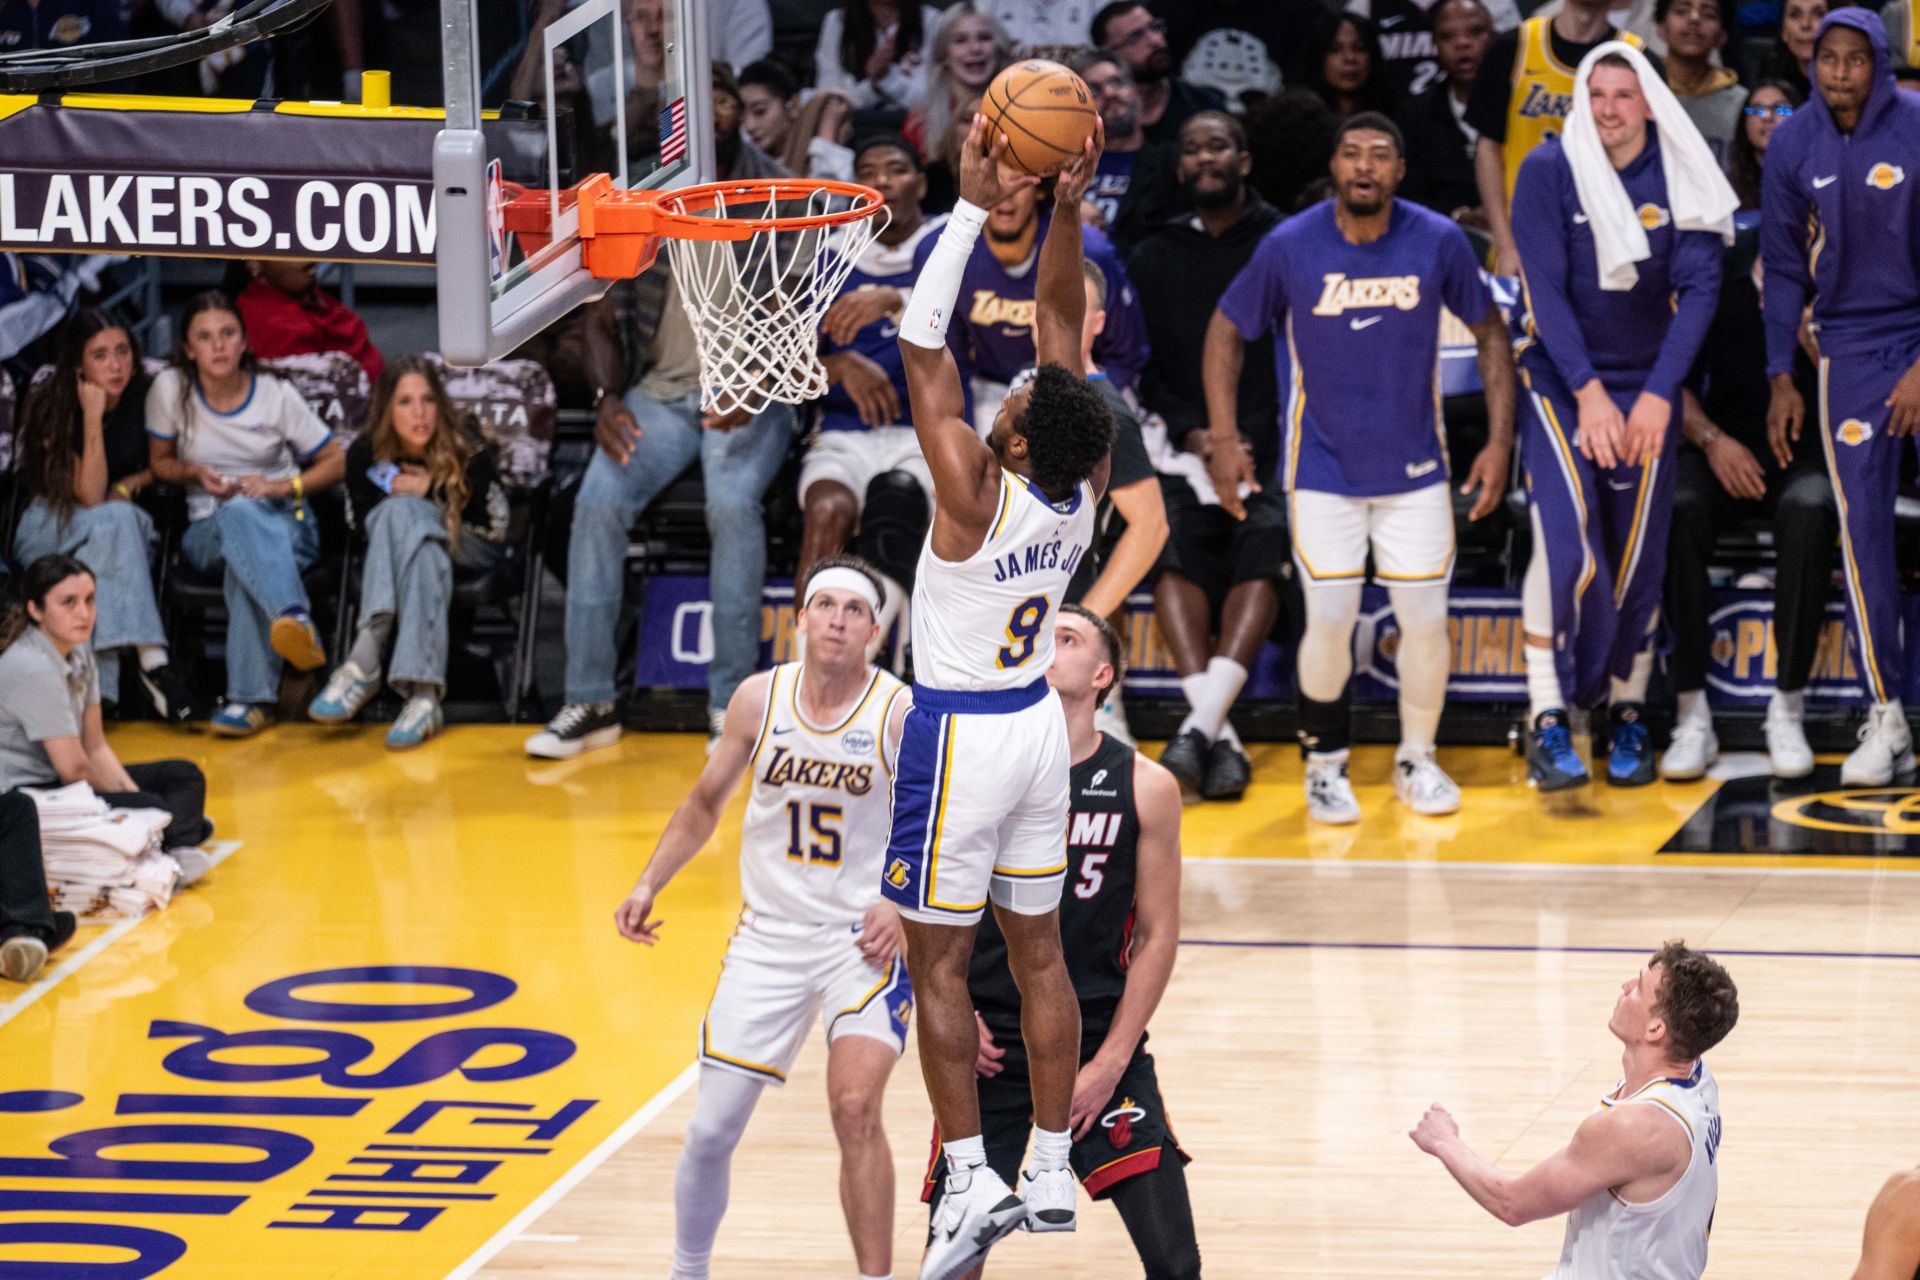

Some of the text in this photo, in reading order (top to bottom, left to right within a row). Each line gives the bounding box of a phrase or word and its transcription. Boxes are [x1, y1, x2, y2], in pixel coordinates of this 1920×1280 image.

[1519, 83, 1574, 118] LAK
[0, 173, 437, 254] LAKERS.COM
[1311, 272, 1421, 316] LAKERS
[994, 540, 1062, 582] JAMES
[995, 593, 1052, 671] 9
[761, 746, 874, 796] LAKERS
[786, 799, 844, 869] 15
[1073, 853, 1110, 899] 5
